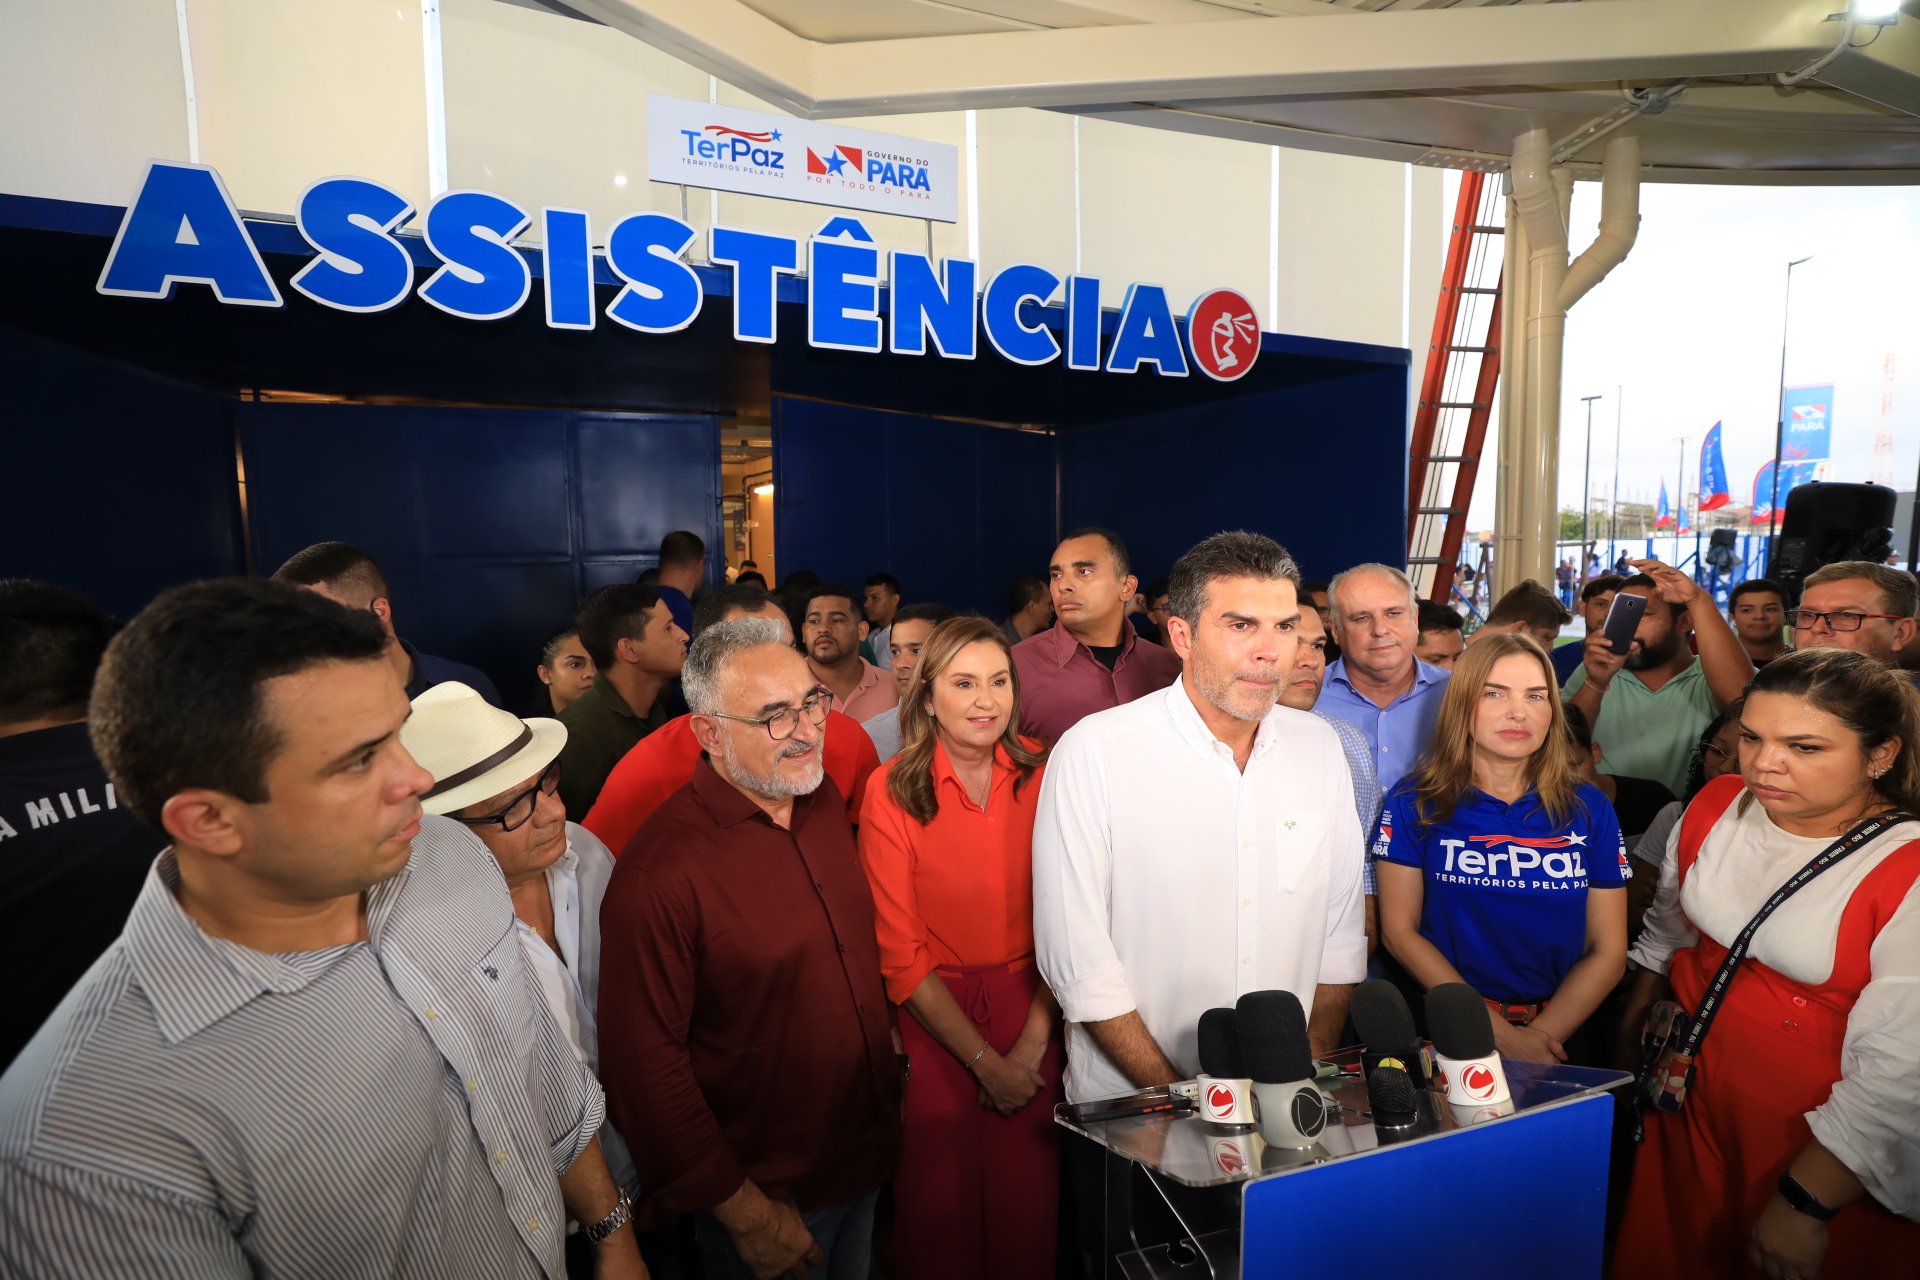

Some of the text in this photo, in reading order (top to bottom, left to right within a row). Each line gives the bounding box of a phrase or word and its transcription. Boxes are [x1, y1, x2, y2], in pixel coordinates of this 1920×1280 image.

[681, 129, 784, 170] TerPaz
[867, 150, 929, 166] GOVERNO DO
[682, 157, 784, 178] TERRITÓRIOS PELA PAZ
[867, 158, 931, 192] PARÁ
[806, 175, 831, 185] POR
[841, 180, 875, 191] TODO
[900, 190, 931, 200] PARÁ
[96, 158, 1189, 378] ASSISTÊNCIA
[1440, 839, 1587, 879] TerPaz
[1435, 872, 1526, 888] TERRITÓRIOS
[1533, 881, 1569, 889] PELA
